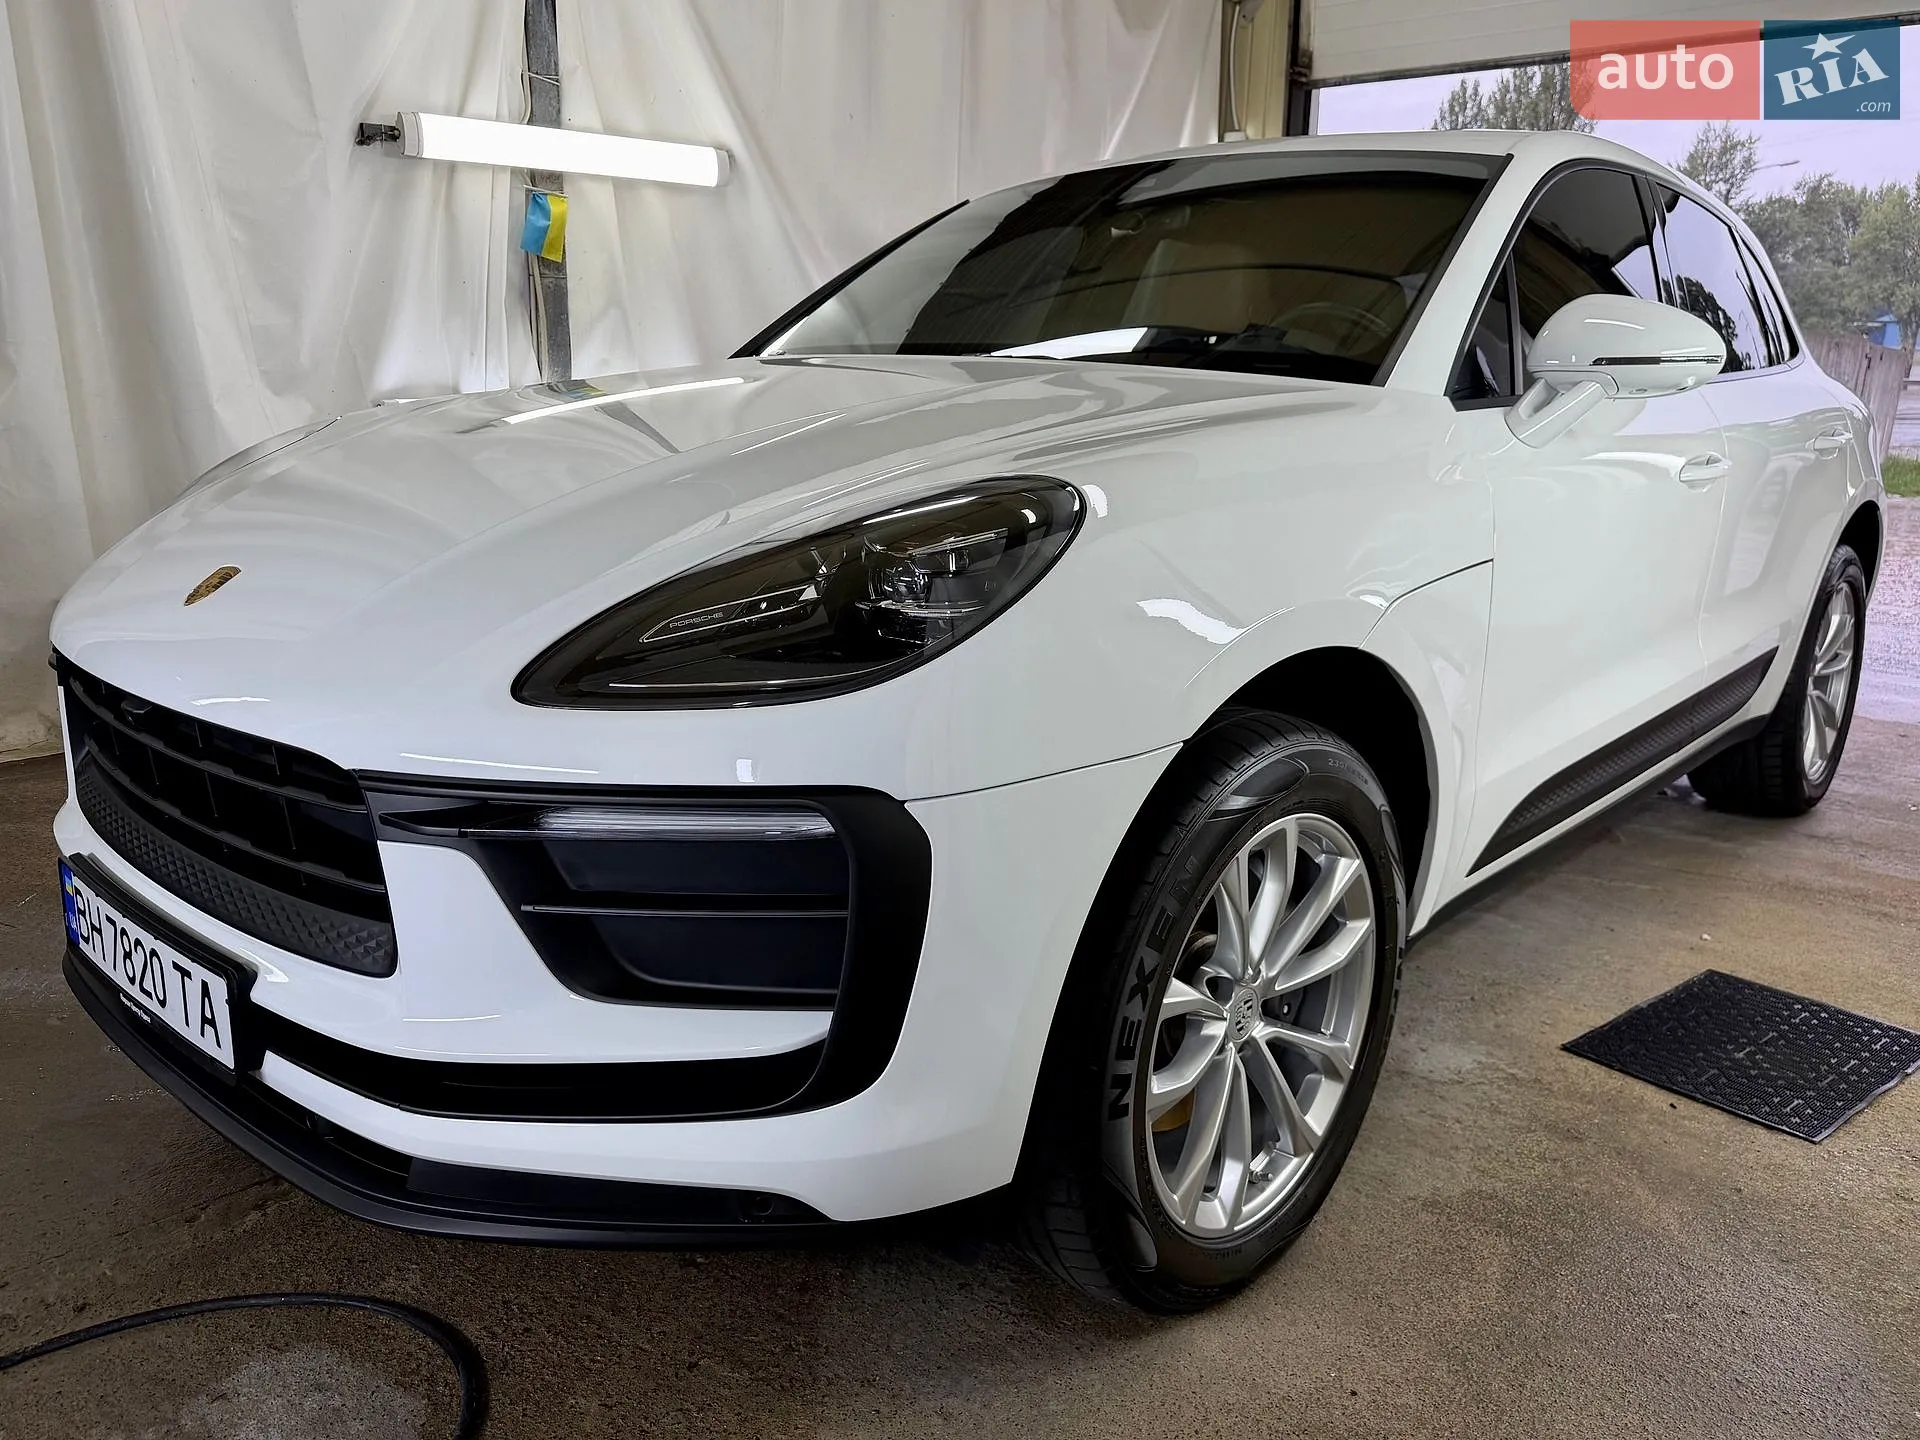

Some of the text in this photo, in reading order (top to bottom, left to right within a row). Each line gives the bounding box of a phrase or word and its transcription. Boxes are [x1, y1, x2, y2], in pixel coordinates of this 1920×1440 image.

[669, 611, 724, 629] PORSCHE
[105, 914, 168, 1010] 7820
[171, 959, 222, 1050] TA
[1107, 854, 1199, 1122] NEXEN
